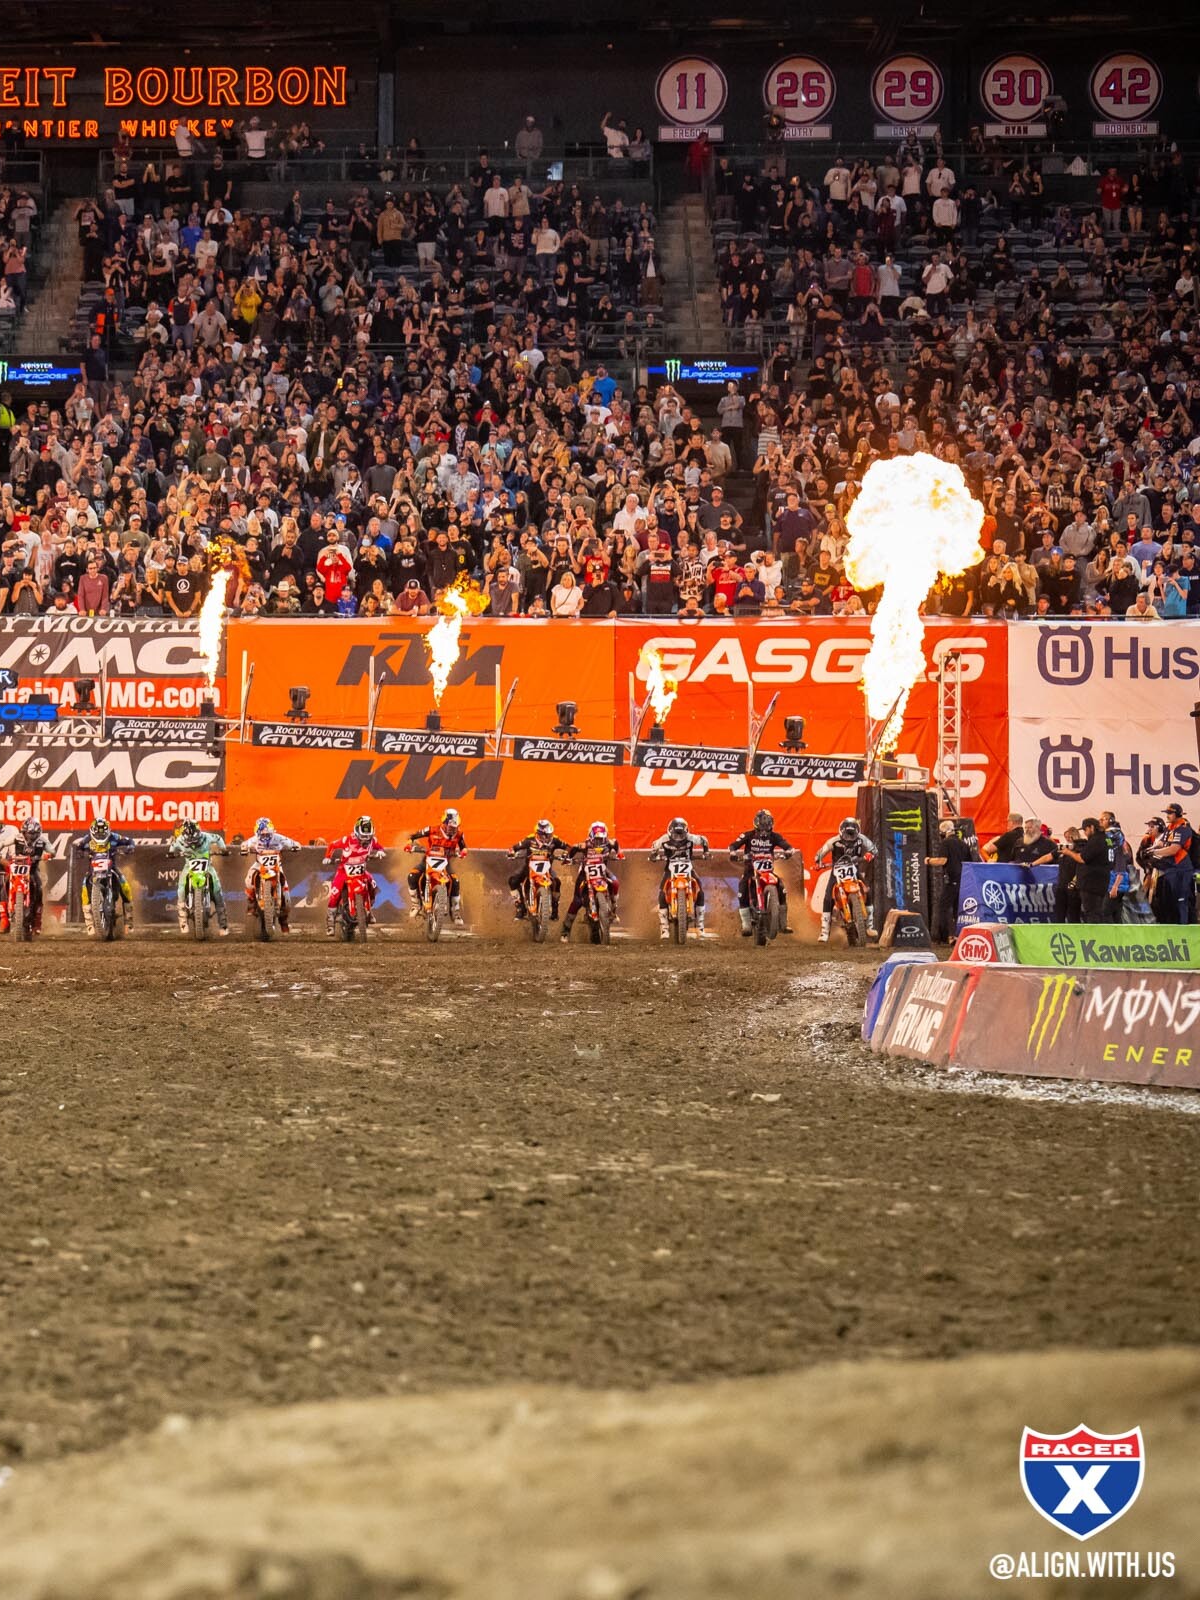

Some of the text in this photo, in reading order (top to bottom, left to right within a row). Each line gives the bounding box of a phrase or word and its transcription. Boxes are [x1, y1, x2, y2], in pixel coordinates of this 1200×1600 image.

[103, 66, 346, 107] BOURBON
[676, 72, 706, 110] 11
[776, 71, 826, 108] 26
[884, 70, 934, 107] 29
[992, 69, 1042, 106] 30
[1099, 68, 1151, 105] 42
[1004, 125, 1028, 135] RYAN
[1104, 124, 1148, 134] ROBINSON
[127, 720, 208, 730] ROCKY MOUNTAIN
[275, 725, 356, 738] ROCKY MOUNTAIN
[397, 733, 479, 745] ROCKY MOUNTAIN
[536, 740, 617, 753] ROCKY MOUNTAIN
[659, 748, 740, 761] ROCKY MOUNTAIN
[777, 756, 858, 769] ROCKY MOUNTAIN
[335, 756, 504, 800] KTM
[97, 859, 108, 872] 3
[190, 860, 208, 872] 21
[261, 855, 278, 867] 25
[429, 857, 445, 871] 7
[534, 861, 545, 873] 1
[755, 861, 773, 872] 78
[12, 865, 28, 875] 10
[347, 864, 364, 876] 23
[588, 864, 604, 878] 51
[672, 863, 690, 874] 12
[836, 867, 855, 880] 34
[910, 851, 921, 904] MONSTER
[1080, 939, 1190, 963] Kawasaki
[1103, 1043, 1193, 1067] ENER
